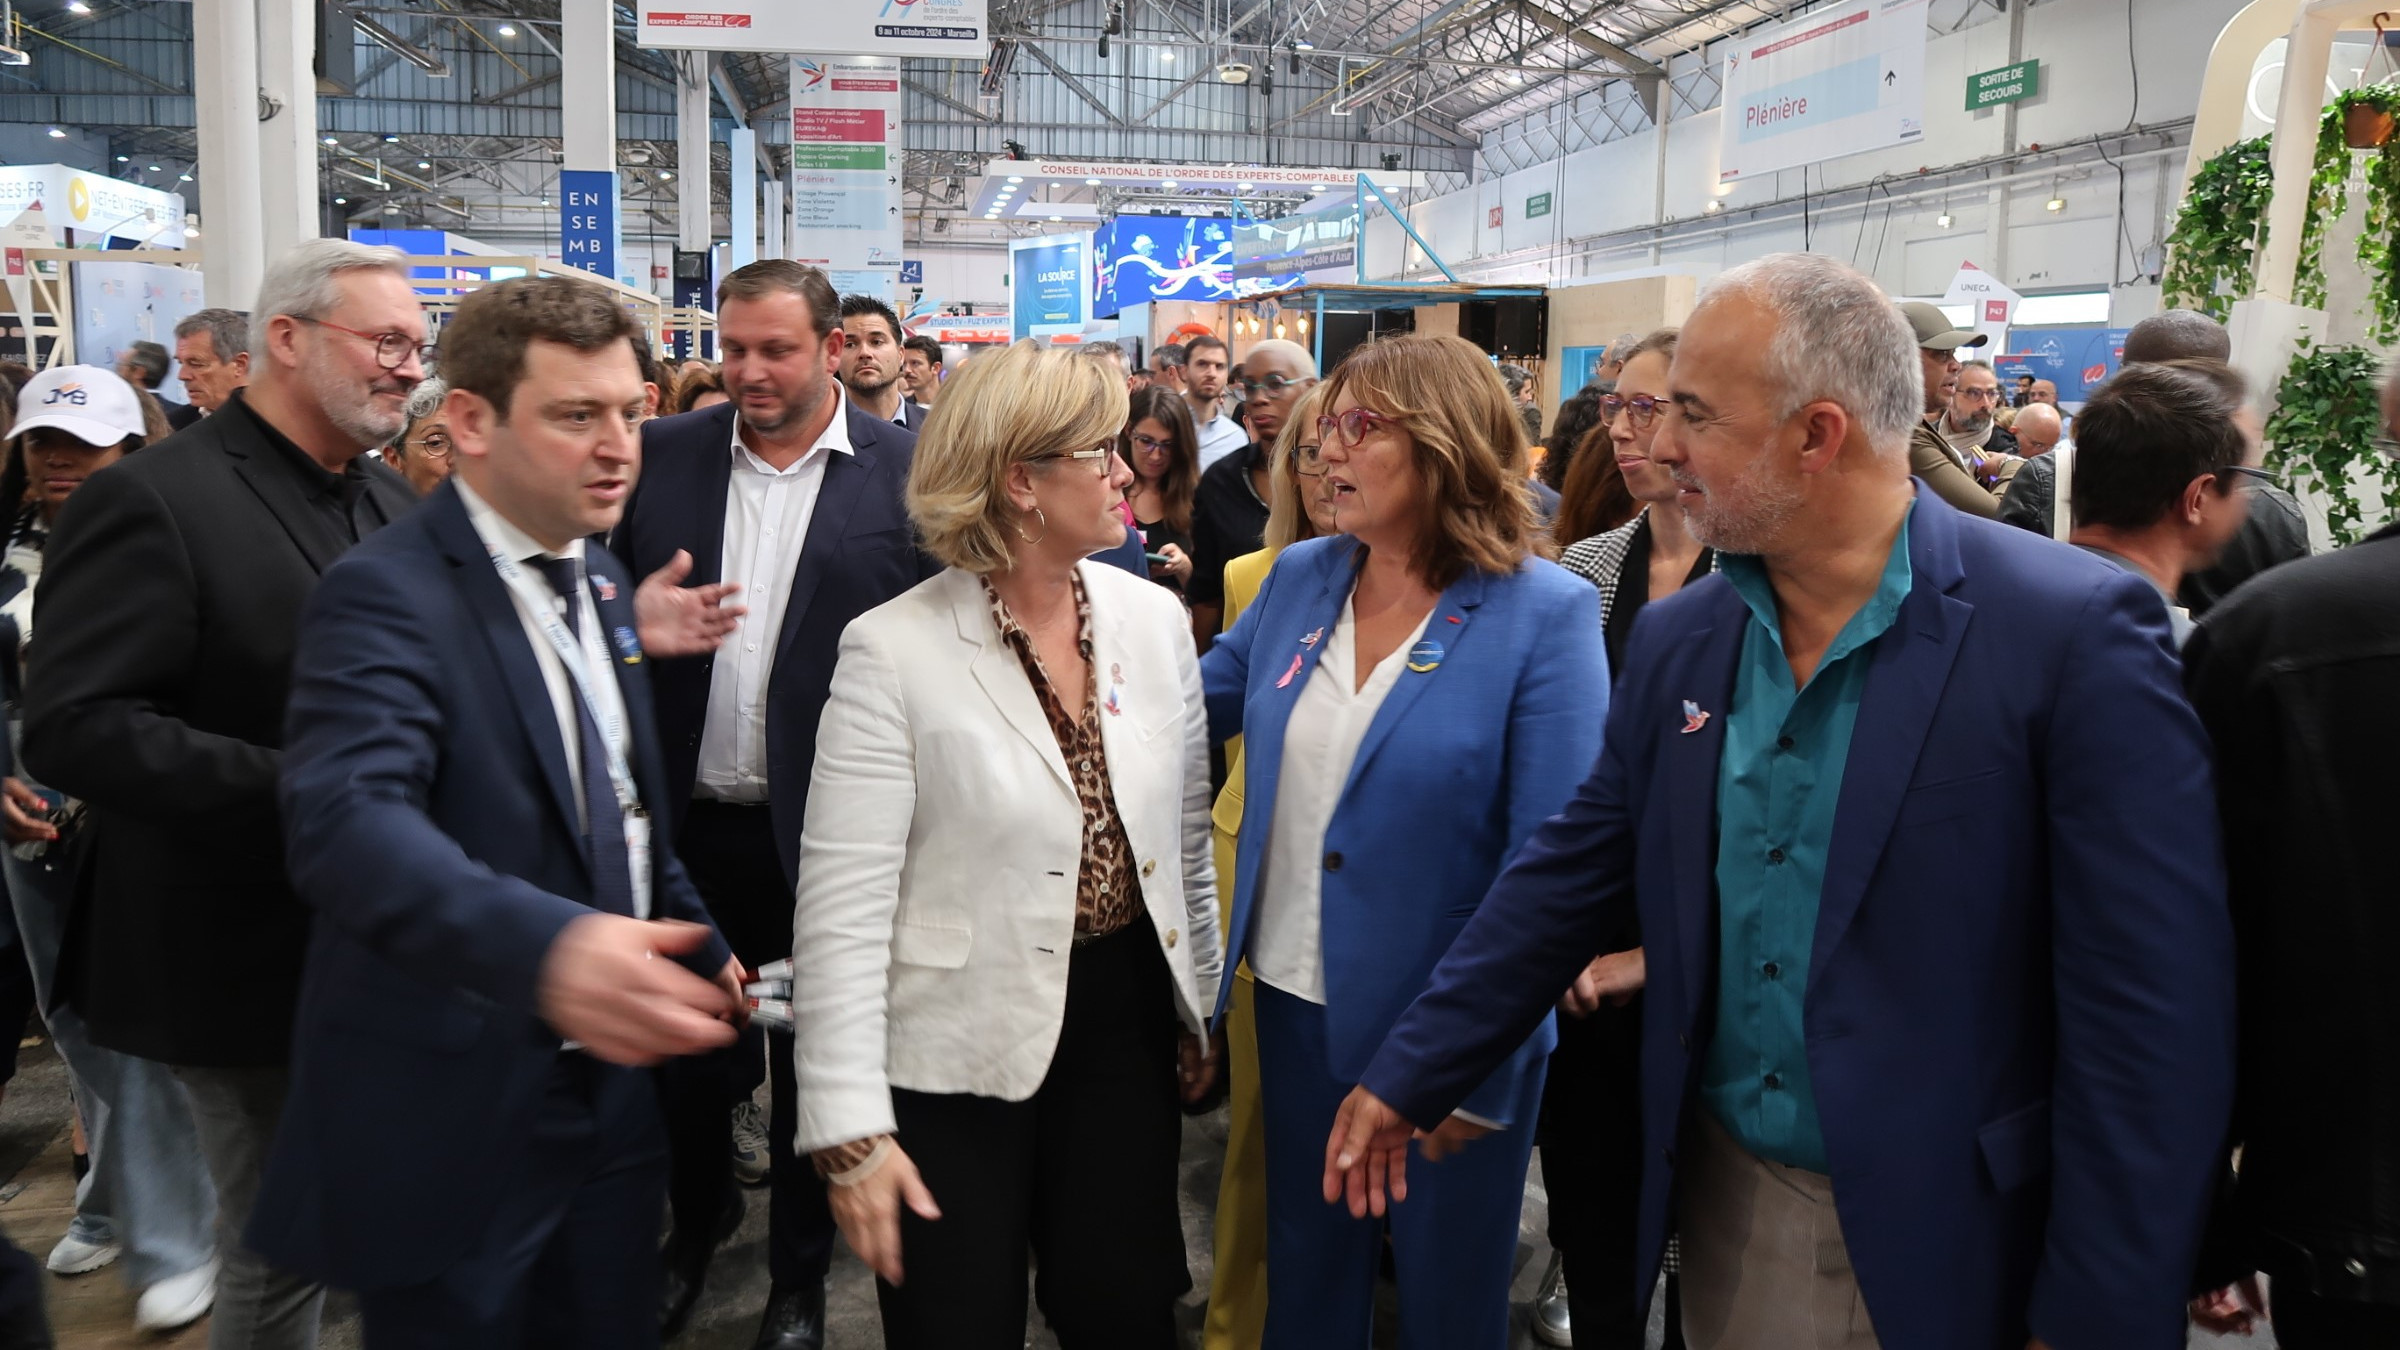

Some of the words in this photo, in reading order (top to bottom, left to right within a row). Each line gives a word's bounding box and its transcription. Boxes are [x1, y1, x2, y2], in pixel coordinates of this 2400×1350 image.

[878, 27, 884, 35] 9
[893, 27, 900, 36] 11
[901, 28, 926, 37] octobre
[926, 28, 942, 37] 2024
[947, 29, 976, 38] Marseille
[1979, 70, 2010, 88] SORTIE
[2011, 67, 2025, 80] DE
[1978, 83, 2023, 103] SECOURS
[1746, 96, 1808, 129] Plénière
[797, 174, 835, 183] Plénière
[1041, 164, 1090, 176] CONSEIL
[1091, 166, 1146, 177] NATIONAL
[1148, 168, 1163, 177] DE
[1165, 168, 1211, 179] L'ORDRE
[1213, 170, 1234, 179] DES
[1237, 170, 1355, 183] EXPERTS-COMPTABLES
[1330, 251, 1353, 263] d'Azur
[1038, 272, 1048, 283] LA
[1048, 268, 1076, 283] SOURCE
[1961, 283, 1991, 293] UNECA
[1989, 307, 2004, 316] P47
[930, 319, 954, 327] STUDIO
